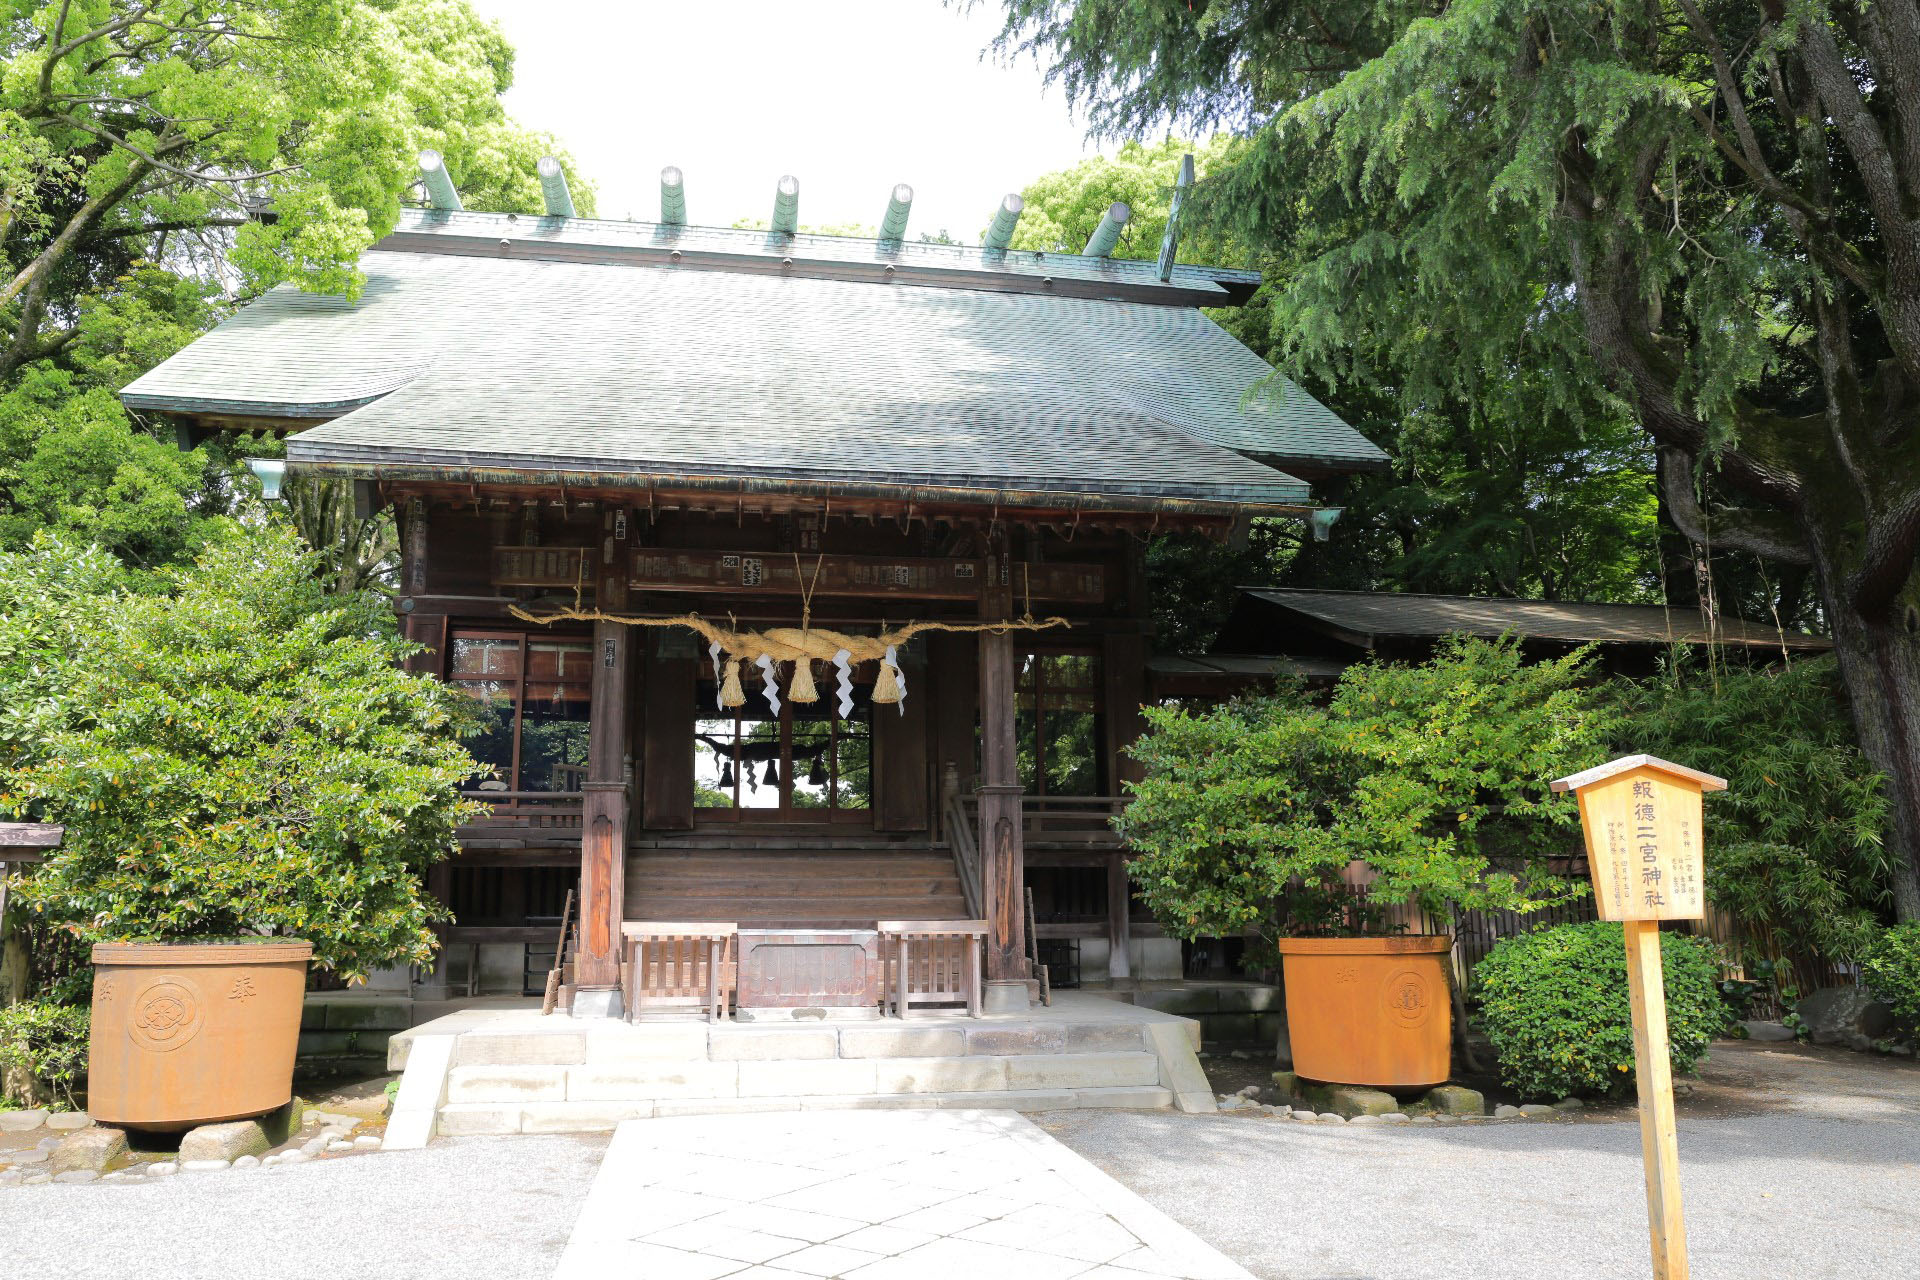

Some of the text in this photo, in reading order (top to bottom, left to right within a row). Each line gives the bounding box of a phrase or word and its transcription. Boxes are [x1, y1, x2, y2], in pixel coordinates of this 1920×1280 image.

[1633, 781, 1665, 908] 報徳二宮神社
